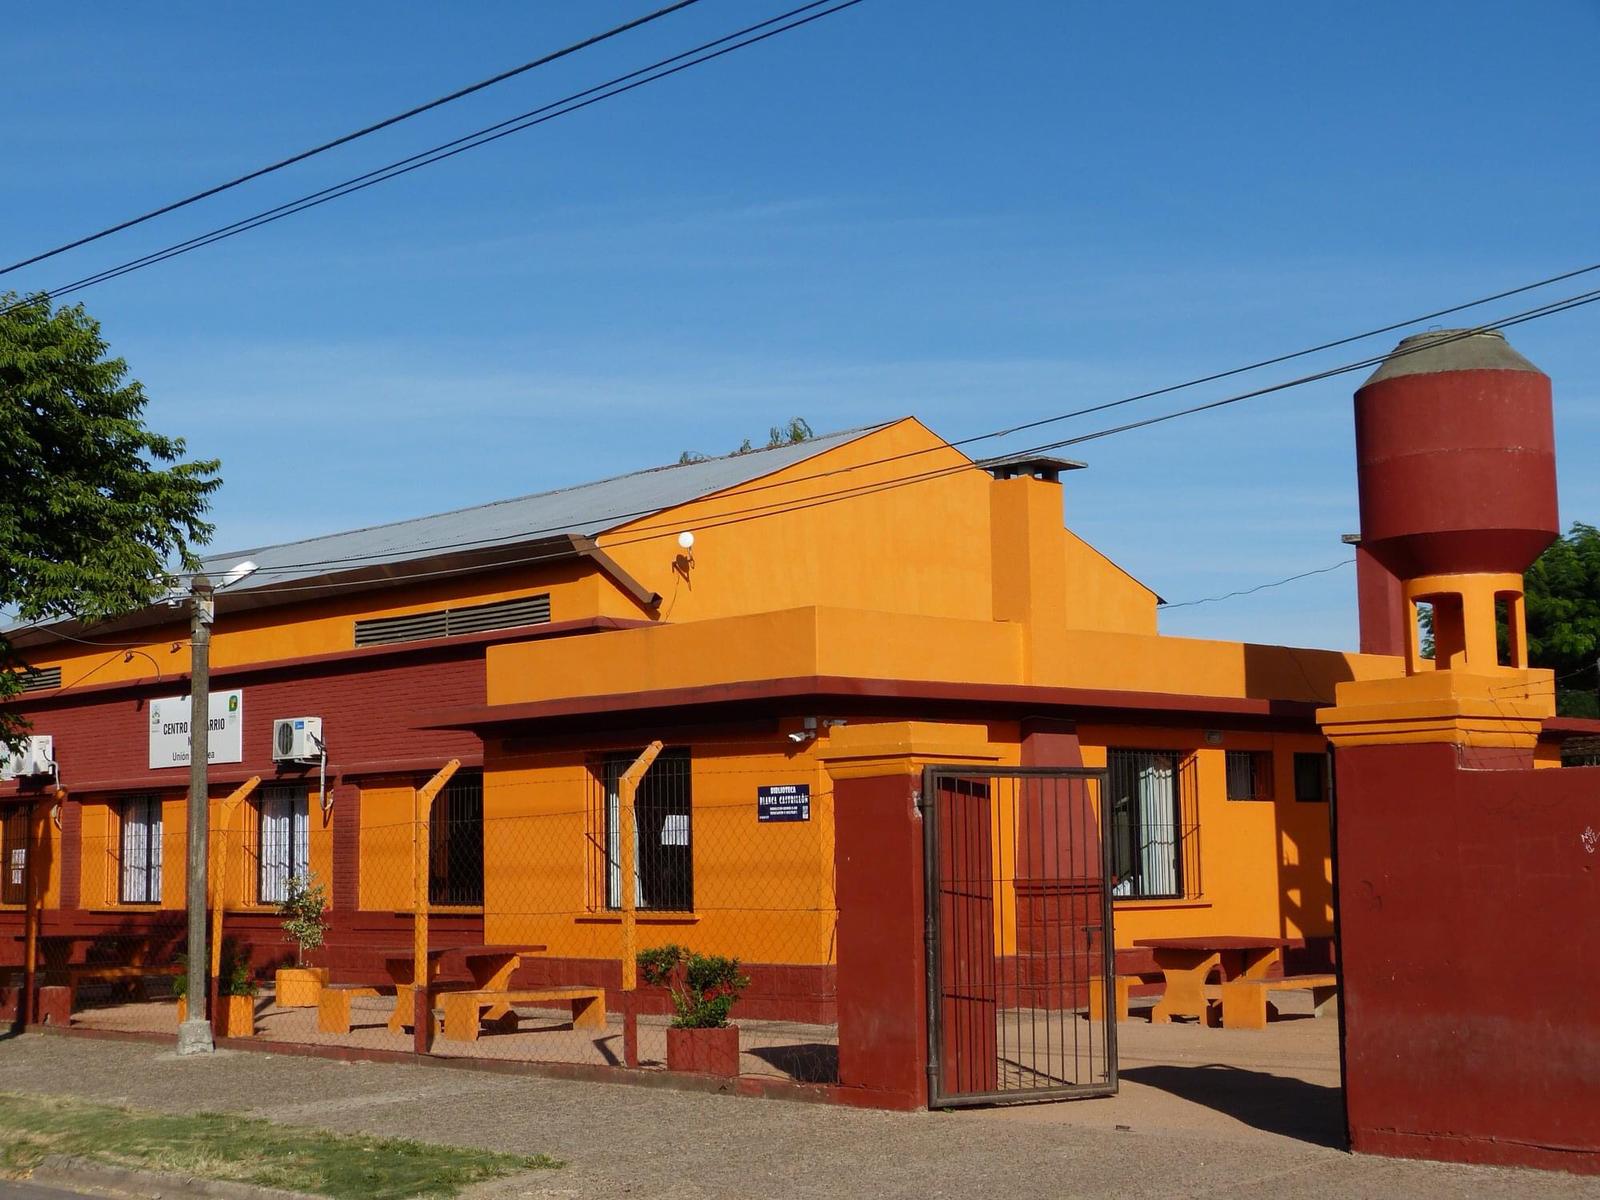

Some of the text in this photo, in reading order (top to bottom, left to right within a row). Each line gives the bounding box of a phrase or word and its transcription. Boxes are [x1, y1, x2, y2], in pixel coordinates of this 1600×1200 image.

[163, 721, 188, 735] CENTRO
[206, 718, 225, 731] RRIO
[770, 786, 797, 794] BIBLIOTECA
